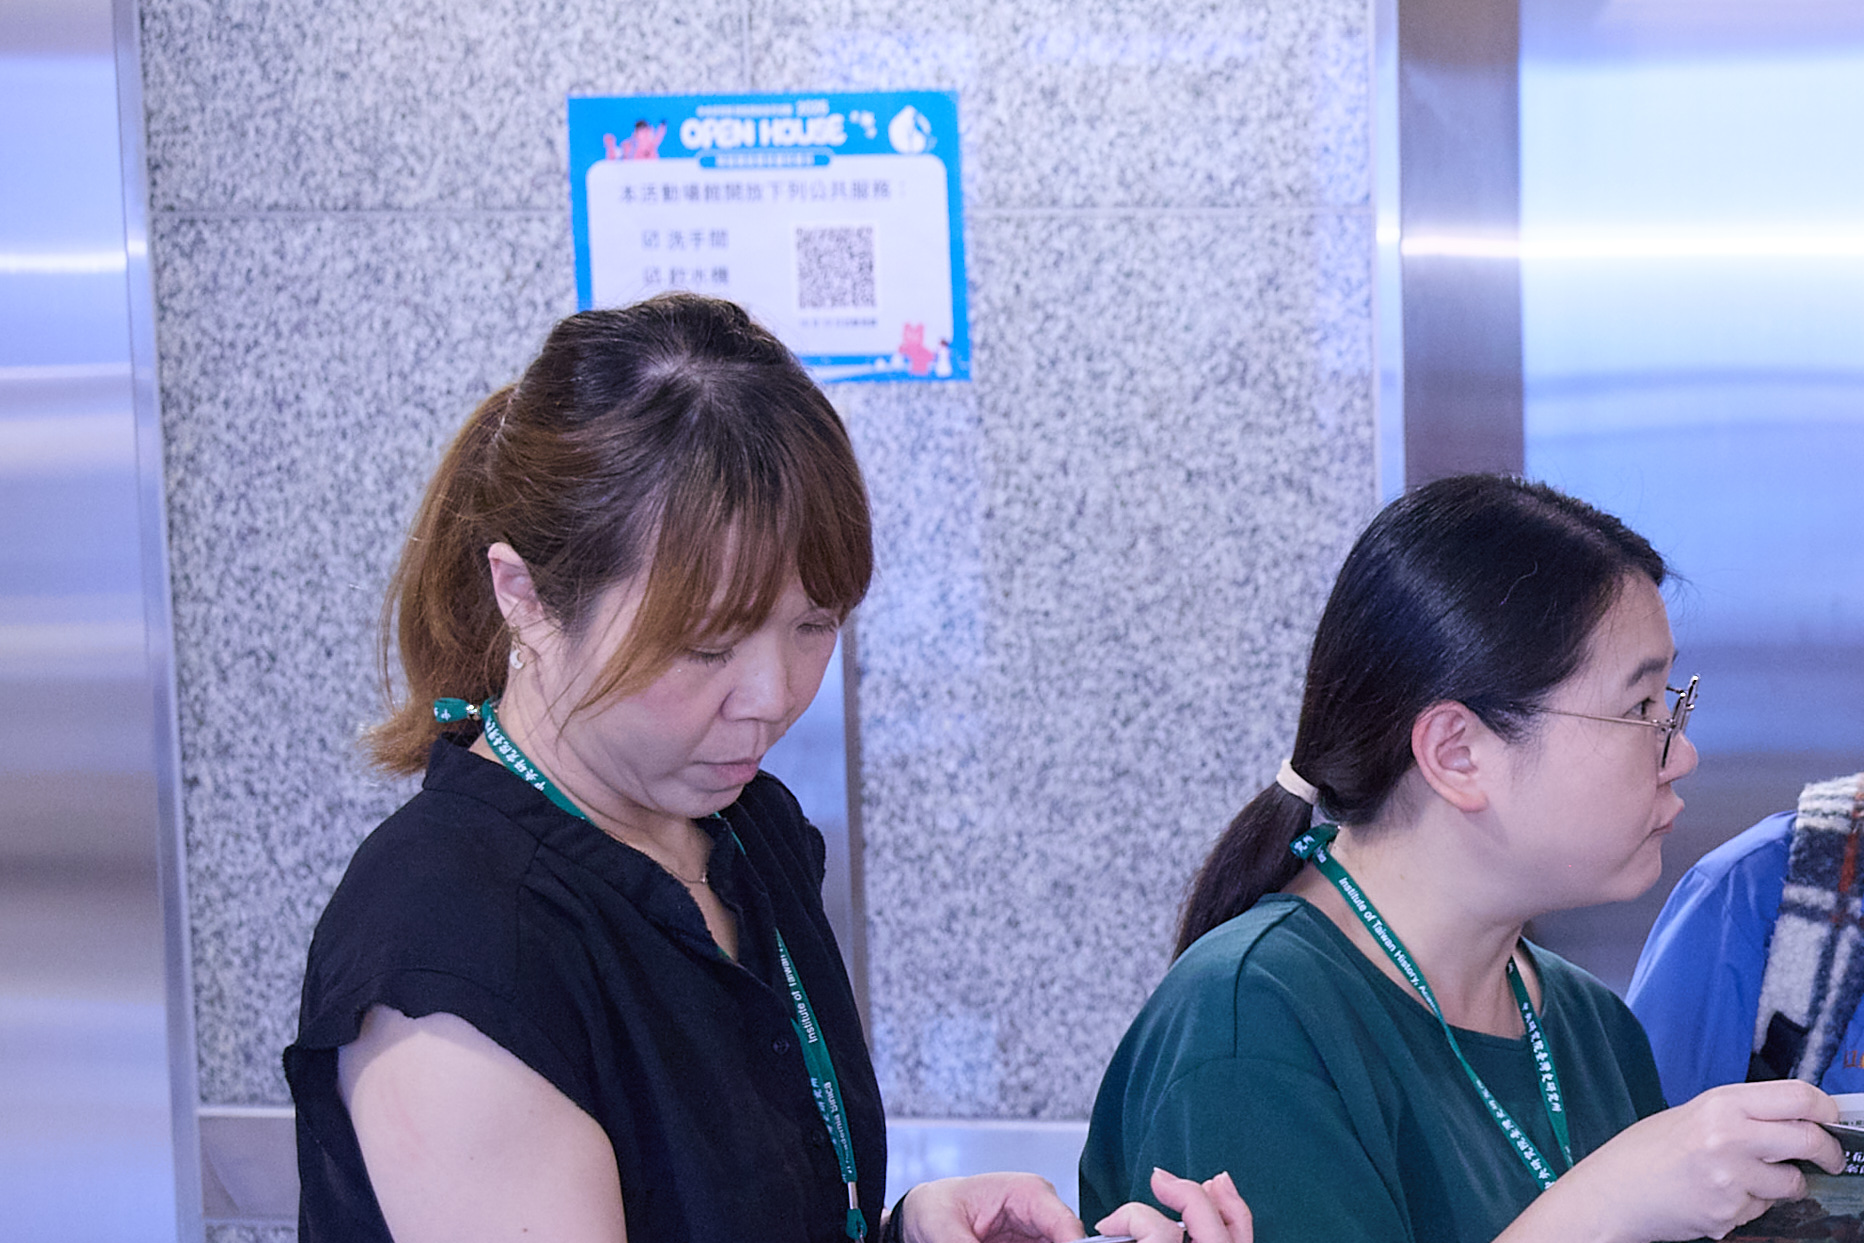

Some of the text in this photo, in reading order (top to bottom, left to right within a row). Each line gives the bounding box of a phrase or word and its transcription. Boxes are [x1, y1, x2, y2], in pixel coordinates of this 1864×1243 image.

[680, 114, 847, 149] OPEN HOUSE
[1338, 877, 1368, 912] Institute
[1364, 910, 1376, 922] of
[1372, 919, 1397, 952] Taiwan
[1394, 950, 1421, 986] History,
[797, 1002, 818, 1043] Institute
